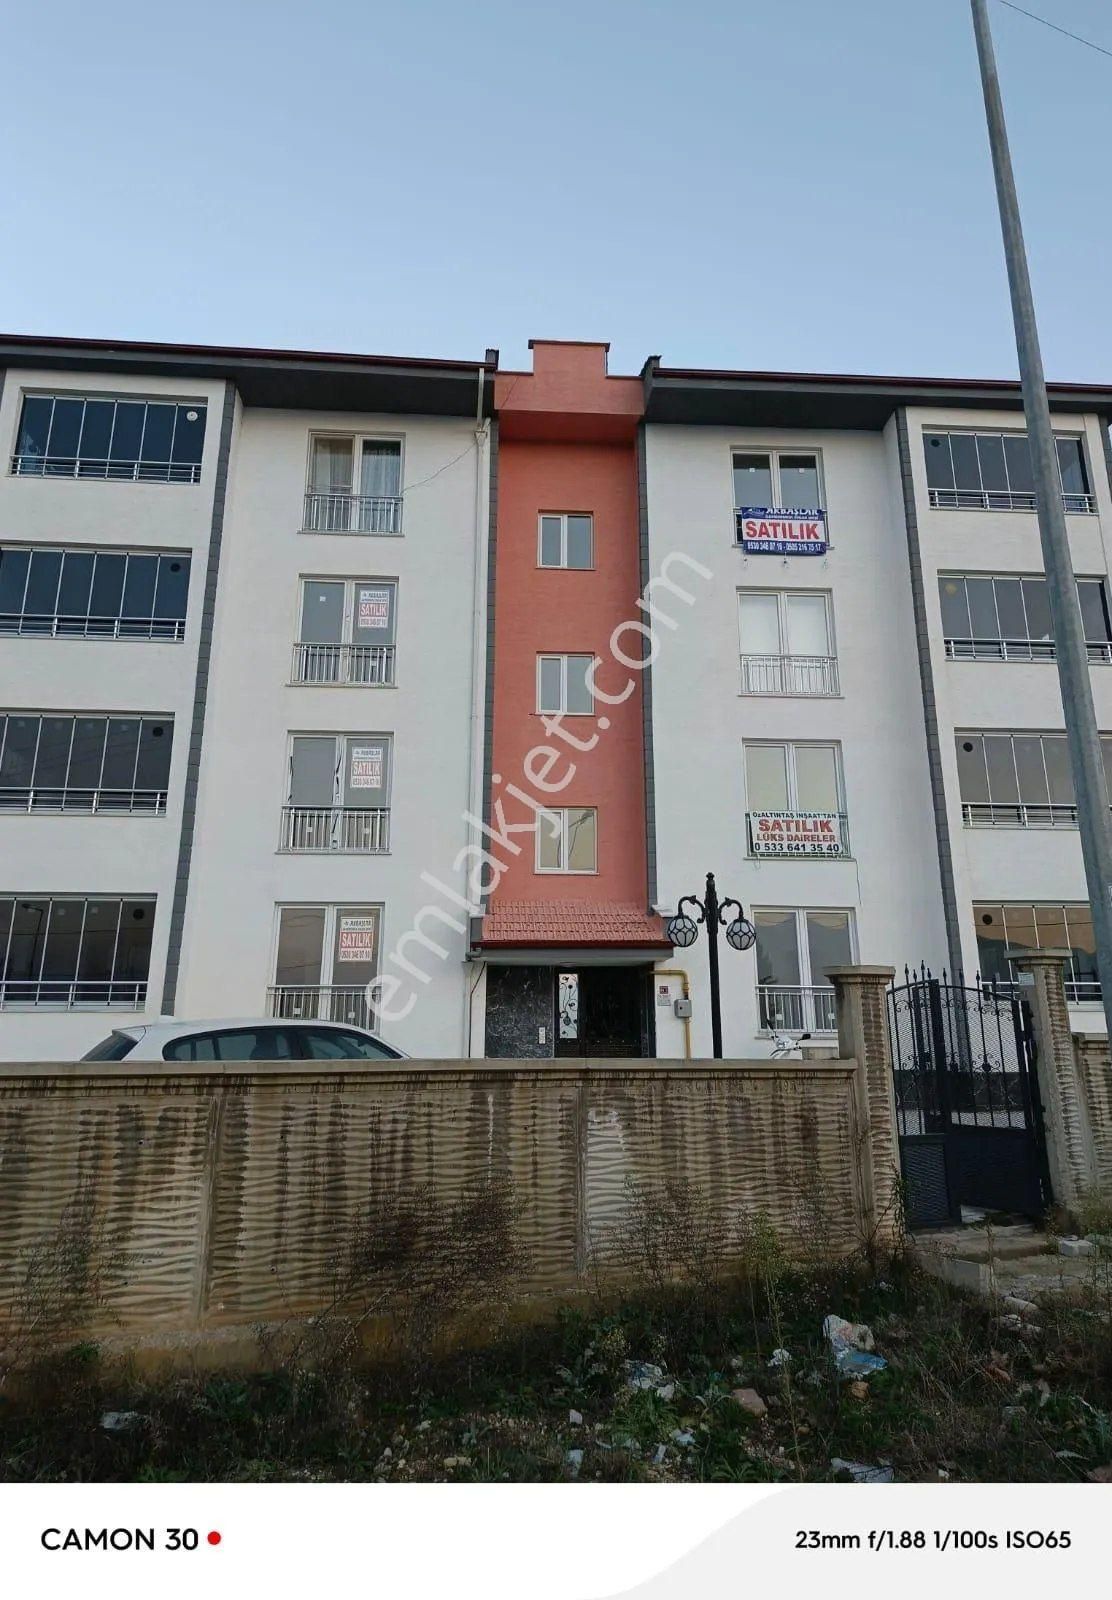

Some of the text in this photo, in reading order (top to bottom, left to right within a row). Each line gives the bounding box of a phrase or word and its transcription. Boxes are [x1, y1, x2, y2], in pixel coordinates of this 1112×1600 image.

[745, 521, 820, 540] SATILIK
[360, 603, 387, 616] SATILIK
[353, 761, 381, 776] SATILIK
[759, 819, 833, 832] SATILIK
[755, 843, 839, 852] 0 533 641 35 40
[342, 933, 371, 947] SATILIK
